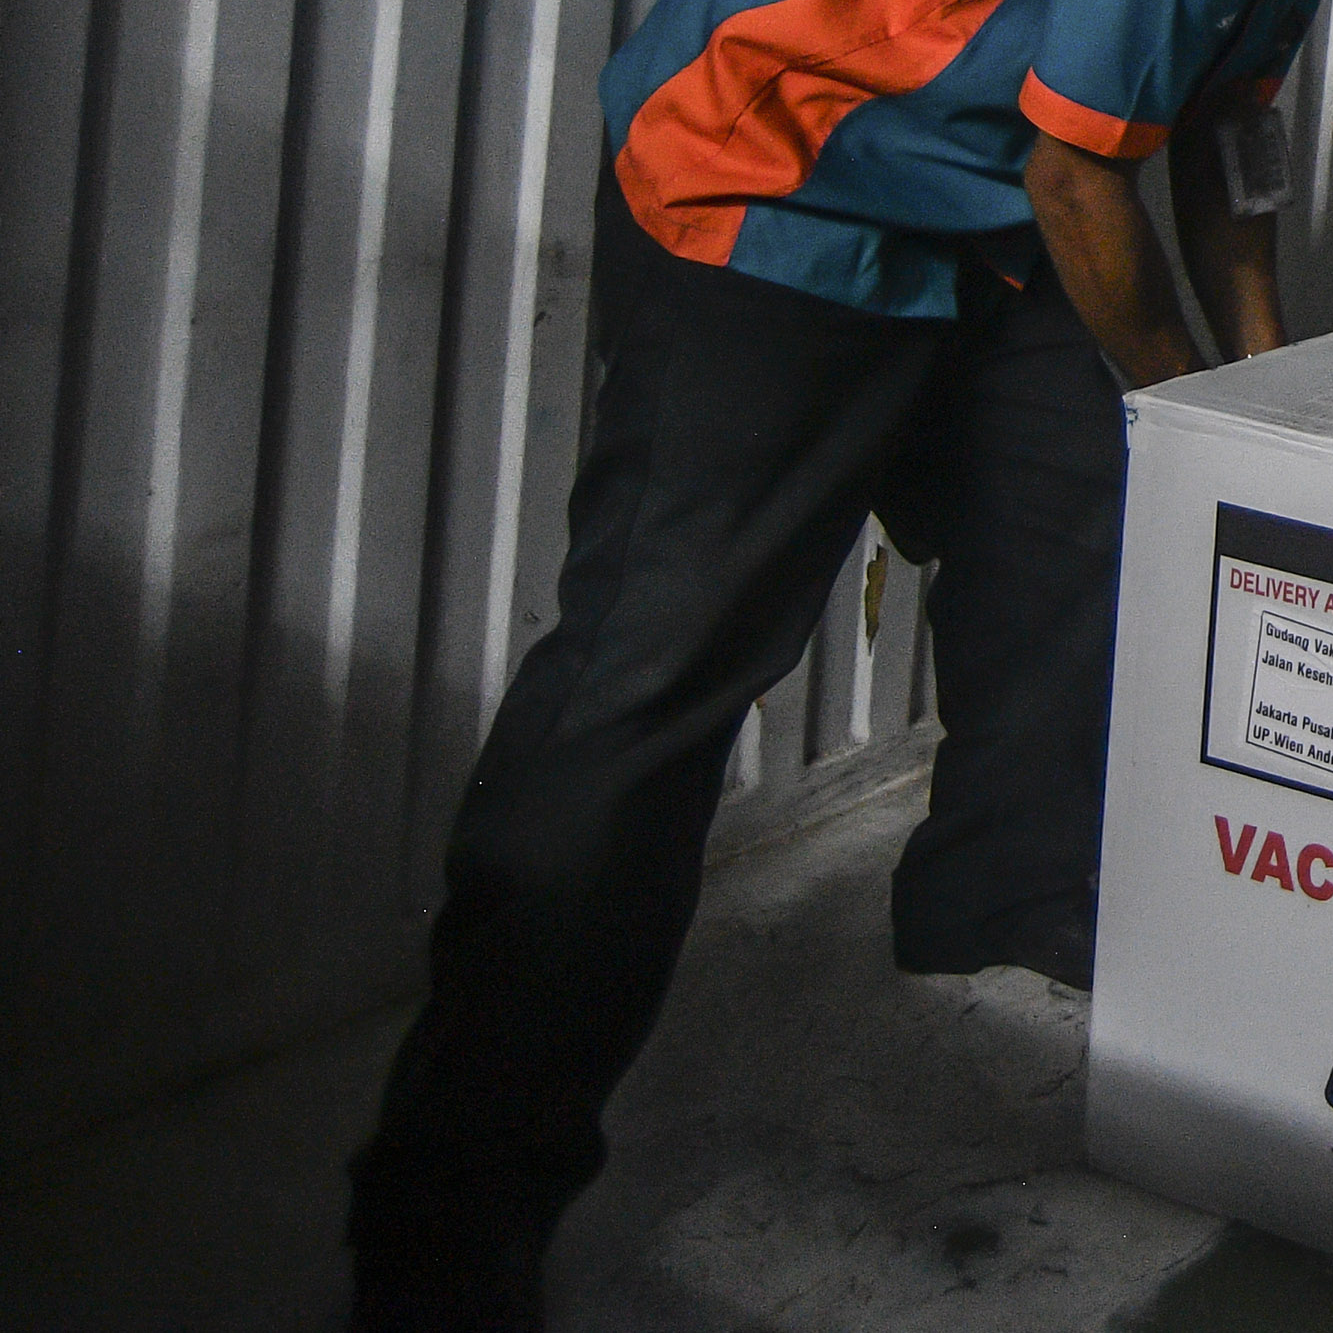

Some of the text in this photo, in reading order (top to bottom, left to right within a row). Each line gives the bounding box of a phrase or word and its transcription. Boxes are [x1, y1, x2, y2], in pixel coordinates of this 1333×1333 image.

[1229, 567, 1321, 610] DELIVERY
[1265, 622, 1310, 652] Gudang
[1261, 650, 1294, 673] Jalan
[1255, 700, 1298, 728] Jakarta
[1252, 724, 1304, 756] UP.Wien
